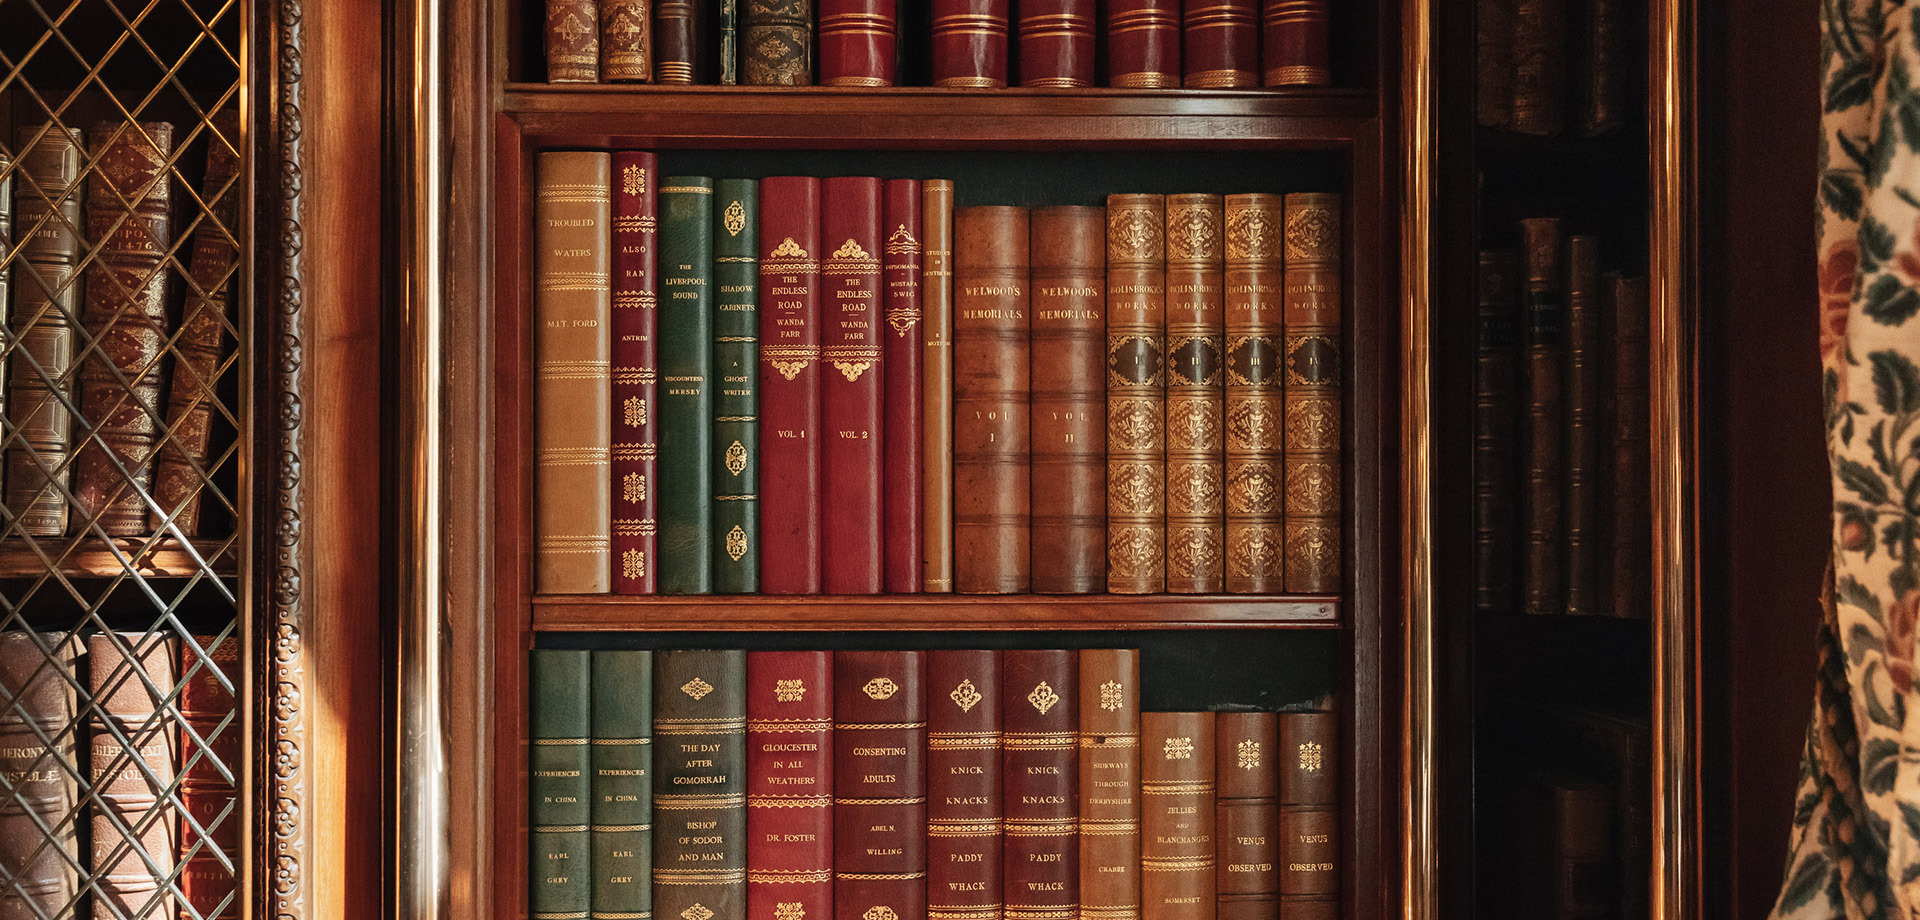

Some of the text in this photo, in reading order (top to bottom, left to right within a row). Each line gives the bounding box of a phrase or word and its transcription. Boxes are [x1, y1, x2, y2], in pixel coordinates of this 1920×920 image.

[548, 219, 594, 227] TROUBLED
[554, 249, 591, 257] WATERS
[665, 278, 707, 286] LIVERPOOL
[772, 287, 808, 295] ENDLESS
[966, 285, 1020, 296] WELWOOD'S
[1042, 286, 1098, 297] WELWOOD'S
[836, 291, 873, 299] ENDLESS
[778, 301, 802, 309] ROAD
[1116, 302, 1157, 310] WORKS
[1176, 302, 1216, 310] WORKS
[1294, 302, 1335, 310] WORKS
[963, 309, 1022, 319] MEMORIALS
[1040, 310, 1099, 319] MEMORIALS
[573, 320, 598, 328] FORD
[1191, 357, 1199, 366] II
[1250, 357, 1260, 366] III
[778, 430, 805, 438] VOL. 1
[840, 431, 868, 439] VOL. 2
[1065, 434, 1074, 443] II
[680, 744, 721, 752] THE DAY
[762, 743, 818, 752] GLOUCESTER
[853, 747, 907, 756] CONSENTING
[686, 760, 713, 768] AFTER
[773, 761, 804, 769] IN ALL
[950, 766, 984, 775] KNICK
[1027, 766, 1060, 774] KNICK
[673, 775, 726, 785] GOMORRAH
[767, 777, 816, 785] WEATHERS
[863, 775, 896, 783] ADULTS
[946, 796, 989, 805] KNACKS
[1022, 796, 1065, 804] KNACKS
[687, 821, 717, 830] BISHOP
[678, 836, 723, 845] OF SODOR
[766, 834, 816, 842] DR. FOSTER
[1157, 835, 1210, 843] BLANCMANGES
[1236, 836, 1265, 845] VENUS
[1299, 834, 1328, 844] VENUS
[678, 852, 724, 861] AND MAN
[950, 853, 983, 862] PADDY
[1029, 853, 1062, 861] PADDY
[1228, 863, 1272, 872] OBSERVED
[1289, 863, 1334, 872] OBSERVED
[948, 882, 986, 891] WHACK
[1027, 882, 1064, 890] WHACK
